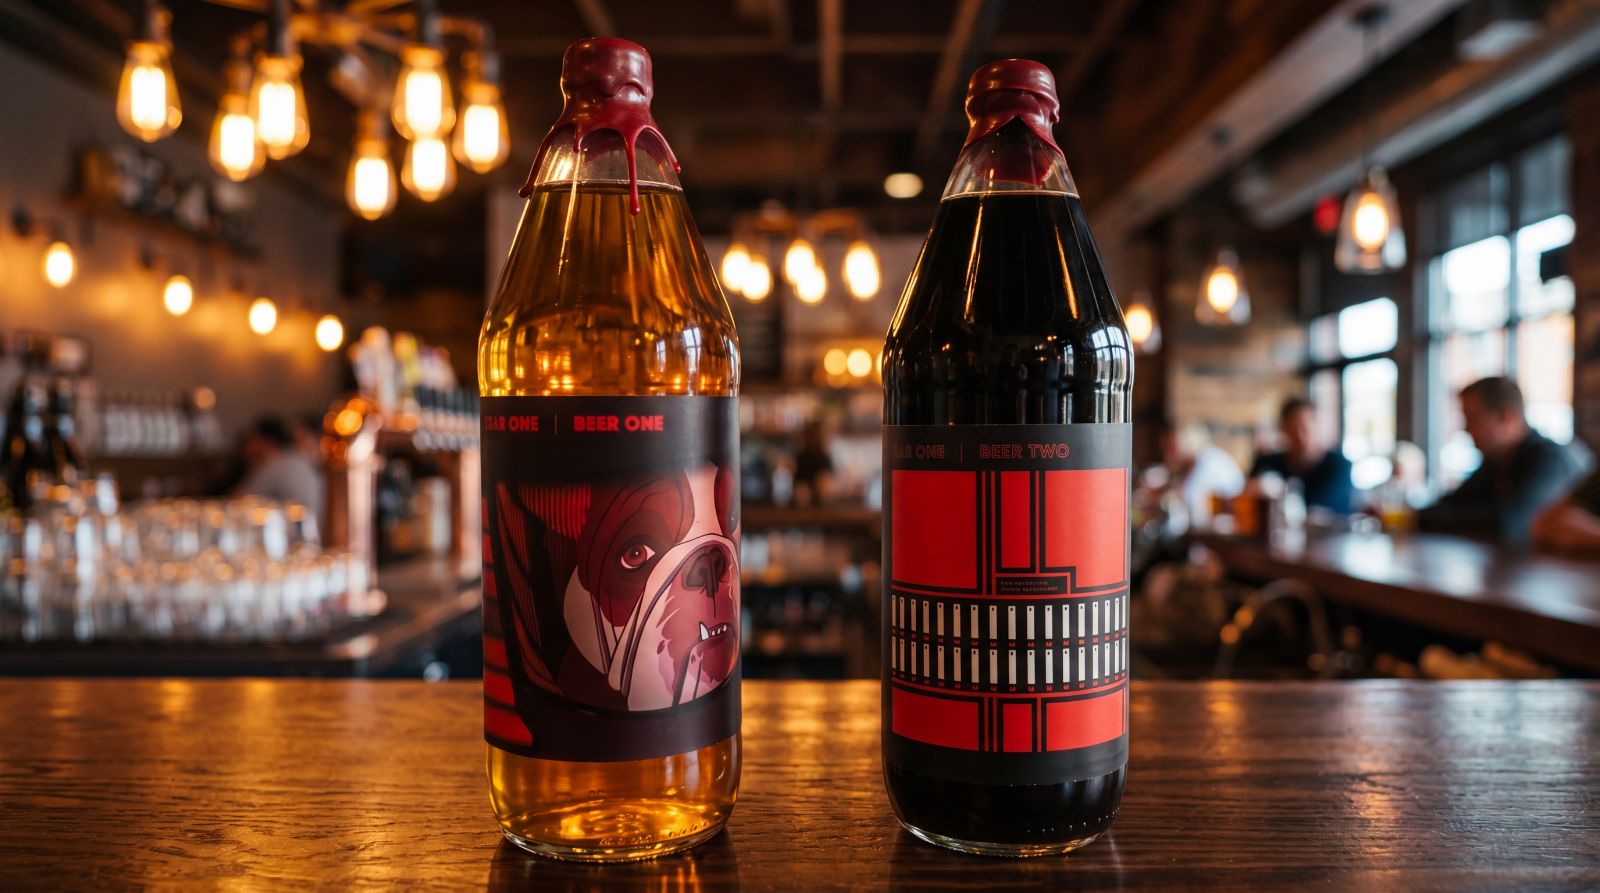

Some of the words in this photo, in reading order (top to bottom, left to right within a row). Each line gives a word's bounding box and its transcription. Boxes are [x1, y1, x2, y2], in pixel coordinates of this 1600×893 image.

[508, 415, 540, 432] ONE
[573, 415, 620, 432] BEER
[624, 415, 664, 432] ONE
[915, 444, 945, 460] ONE
[979, 444, 1022, 459] BEER
[1027, 443, 1070, 459] TWO
